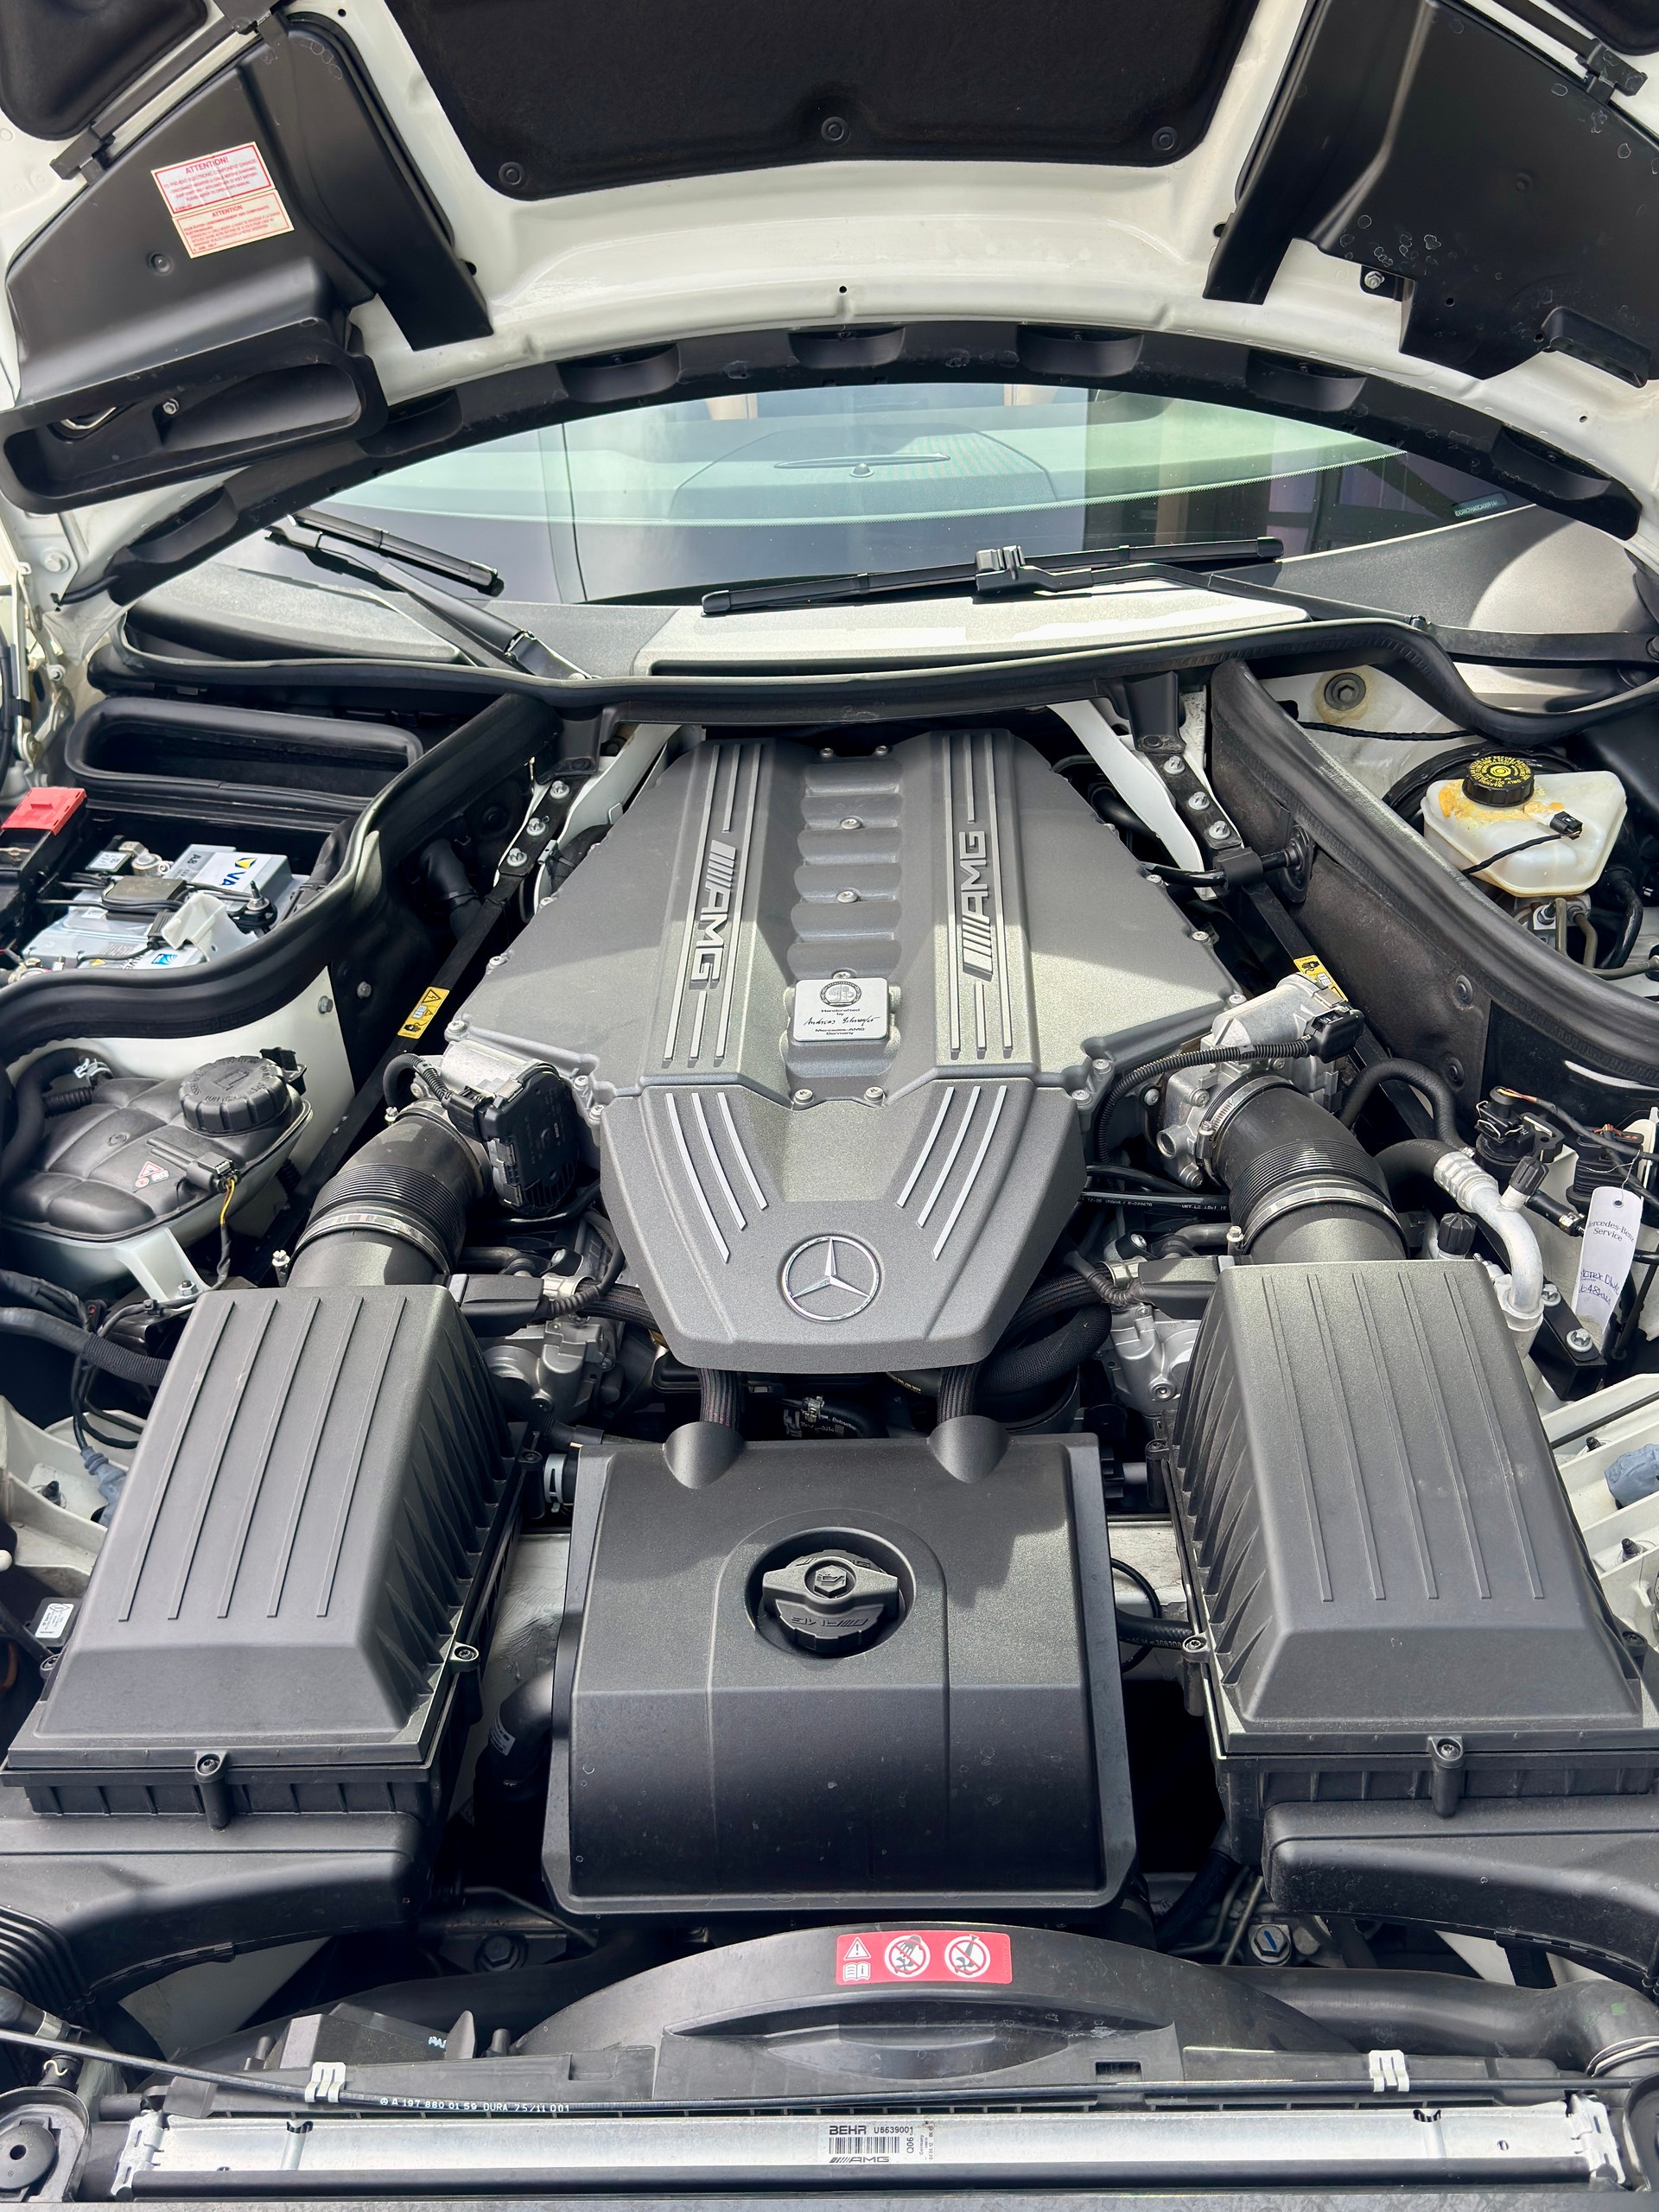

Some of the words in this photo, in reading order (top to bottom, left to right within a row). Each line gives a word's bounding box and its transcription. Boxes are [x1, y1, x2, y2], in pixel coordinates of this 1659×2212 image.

[185, 156, 229, 175] ATTENTION!
[212, 205, 244, 218] ATTENTION
[959, 830, 990, 925] AMG
[690, 880, 732, 982] AMG
[1592, 1227, 1623, 1243] Service
[403, 2099, 420, 2107] 197
[424, 2100, 445, 2109] 880
[448, 2101, 460, 2110] 01
[463, 2101, 478, 2110] 59
[483, 2102, 508, 2112] DURA
[829, 2125, 868, 2135] BEHR
